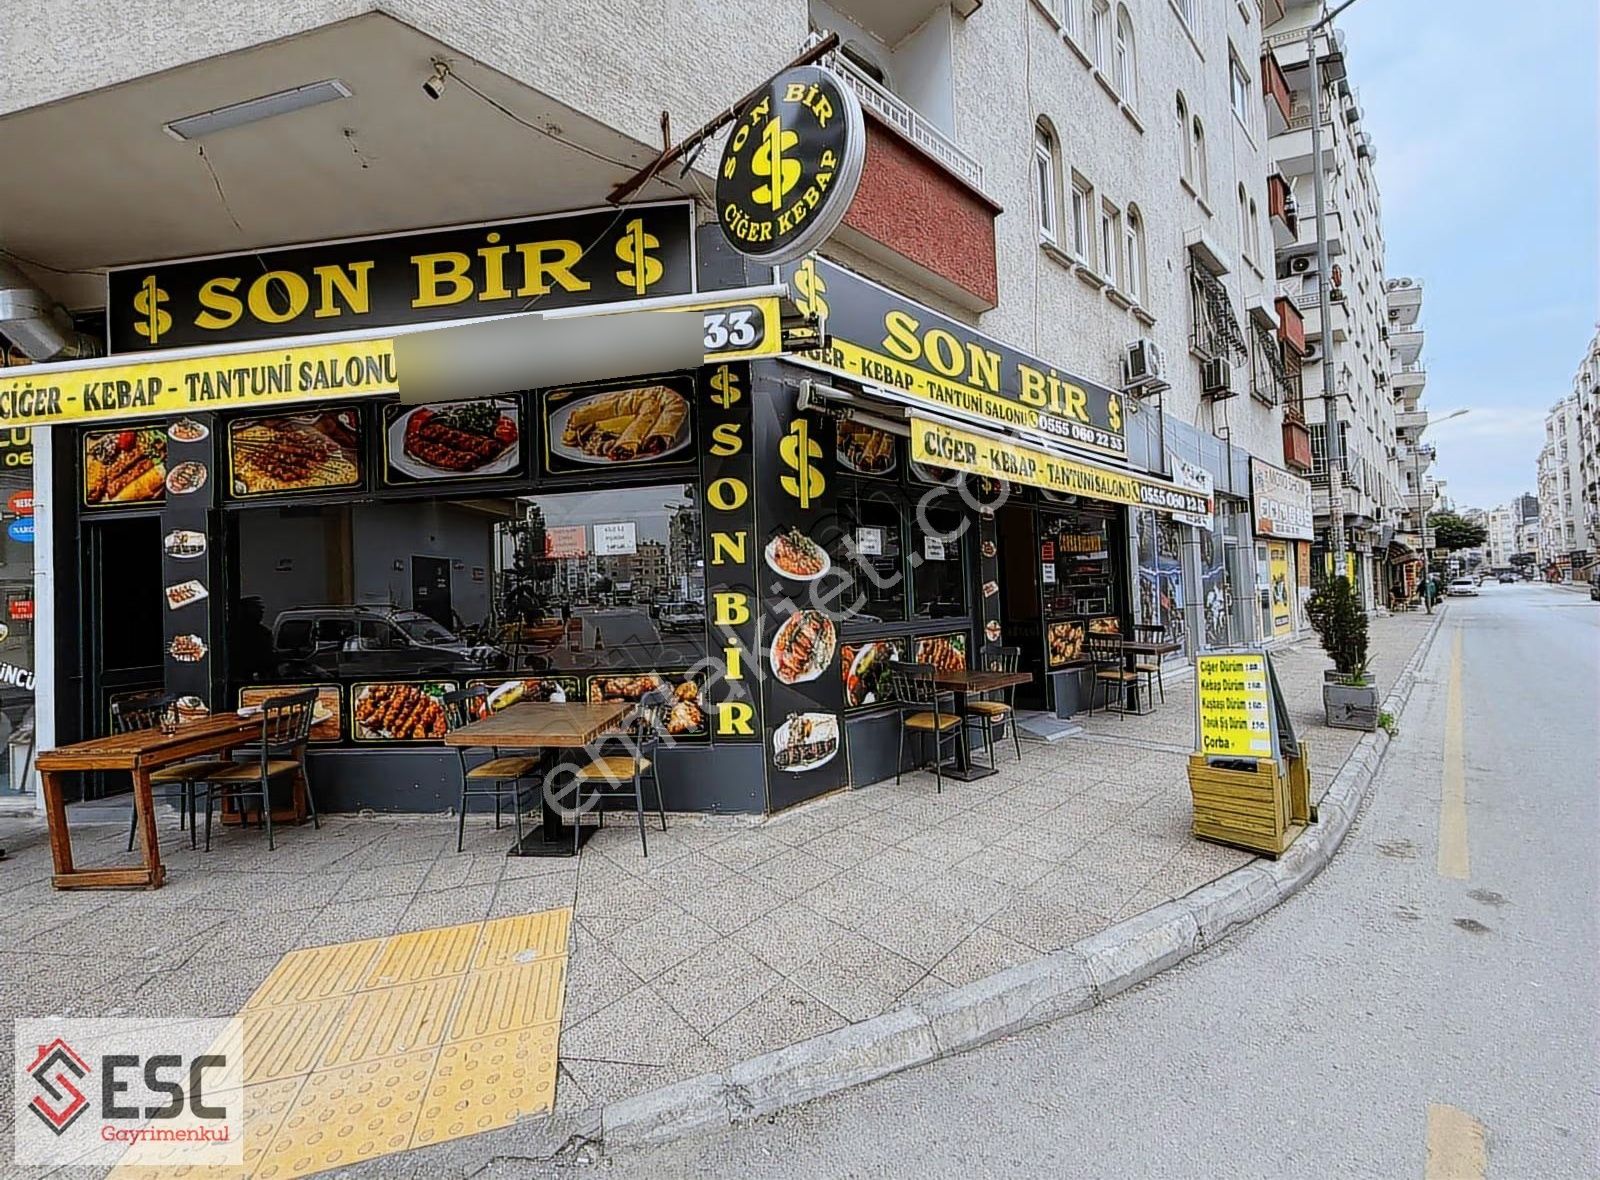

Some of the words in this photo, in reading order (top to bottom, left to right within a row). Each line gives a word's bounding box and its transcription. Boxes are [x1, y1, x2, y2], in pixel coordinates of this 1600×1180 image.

[724, 96, 770, 180] SON
[784, 83, 833, 128] BİR
[725, 203, 773, 242] CİĞER
[778, 149, 838, 236] KEBAP
[193, 260, 375, 330] SON
[410, 232, 592, 309] BİR
[704, 311, 756, 348] 33
[882, 310, 1001, 394] SON
[1017, 368, 1091, 424] BİR
[84, 376, 162, 411] KEBAP
[185, 354, 292, 401] TANTUNİ
[299, 353, 398, 391] SALONU
[861, 357, 914, 391] KEBAP
[926, 381, 984, 414] TANTUNİ
[985, 401, 1028, 425] SALONU
[1039, 415, 1069, 436] 0555
[1072, 425, 1094, 442] 060
[1096, 432, 1108, 447] 22
[925, 428, 976, 465] CİĞER
[990, 449, 1036, 477] KEBAP
[1096, 475, 1131, 498] SALONU
[1141, 485, 1165, 505] 0555
[1219, 659, 1243, 672] Dürüm
[1222, 678, 1245, 691] Dürüm
[1203, 735, 1230, 751] Çorba
